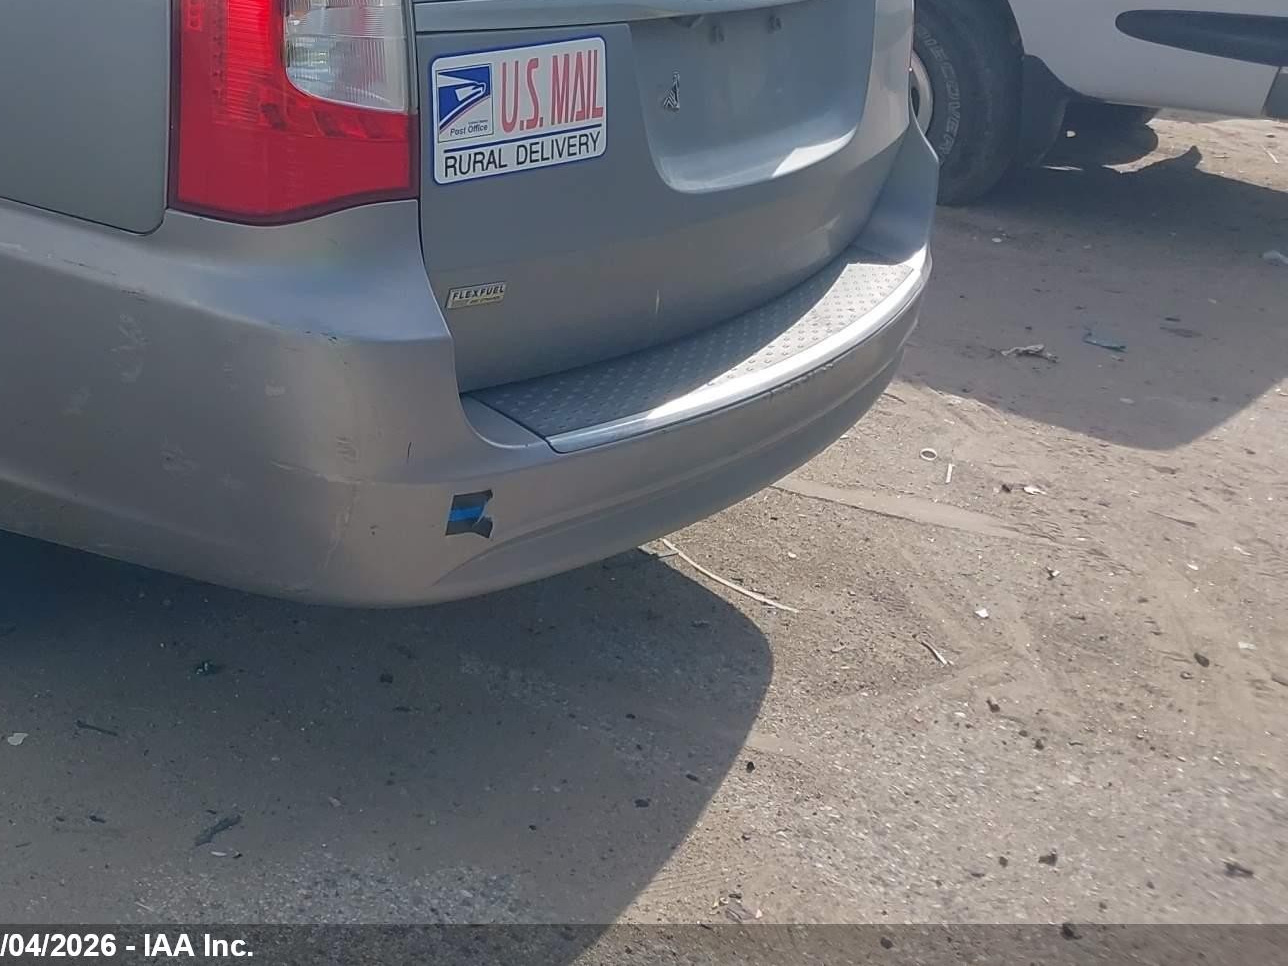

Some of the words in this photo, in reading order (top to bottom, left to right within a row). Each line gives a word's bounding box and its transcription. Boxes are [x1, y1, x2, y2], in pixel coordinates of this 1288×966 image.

[501, 57, 544, 134] U.S.
[551, 49, 604, 126] MAIL
[444, 149, 508, 178] RURAL
[516, 130, 601, 166] DELIVERY
[450, 127, 466, 136] Post
[467, 124, 488, 133] Office
